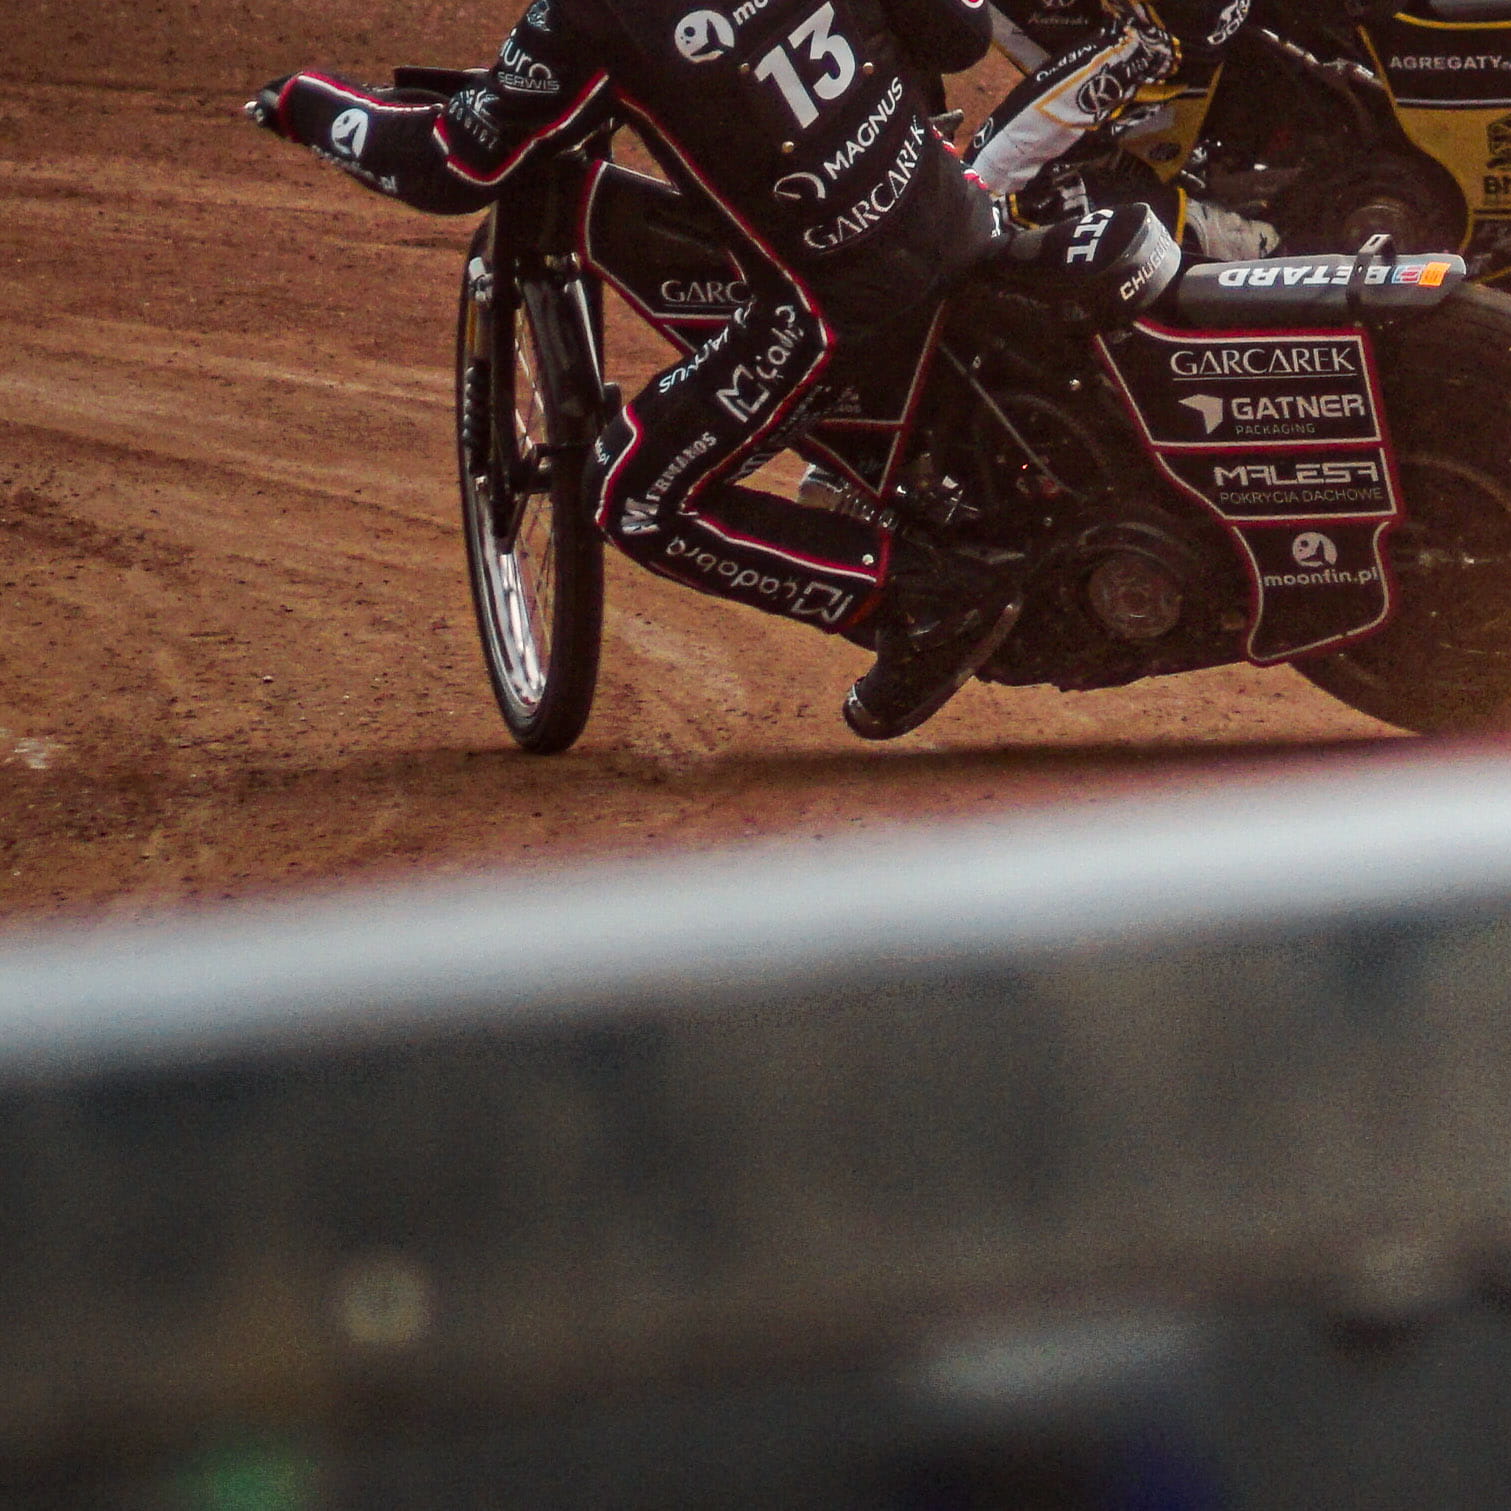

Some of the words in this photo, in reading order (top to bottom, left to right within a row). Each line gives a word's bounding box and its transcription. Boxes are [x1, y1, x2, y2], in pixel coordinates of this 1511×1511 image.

[754, 1, 857, 129] 13
[823, 76, 903, 181] MAGNUS
[1170, 346, 1358, 377] GARCAREK
[1231, 393, 1367, 420] GATNER
[1235, 422, 1317, 436] PACKAGING
[1218, 489, 1299, 506] POKRYCIA
[1301, 486, 1385, 503] DACHOWE
[1263, 566, 1380, 588] moonfin.pl
